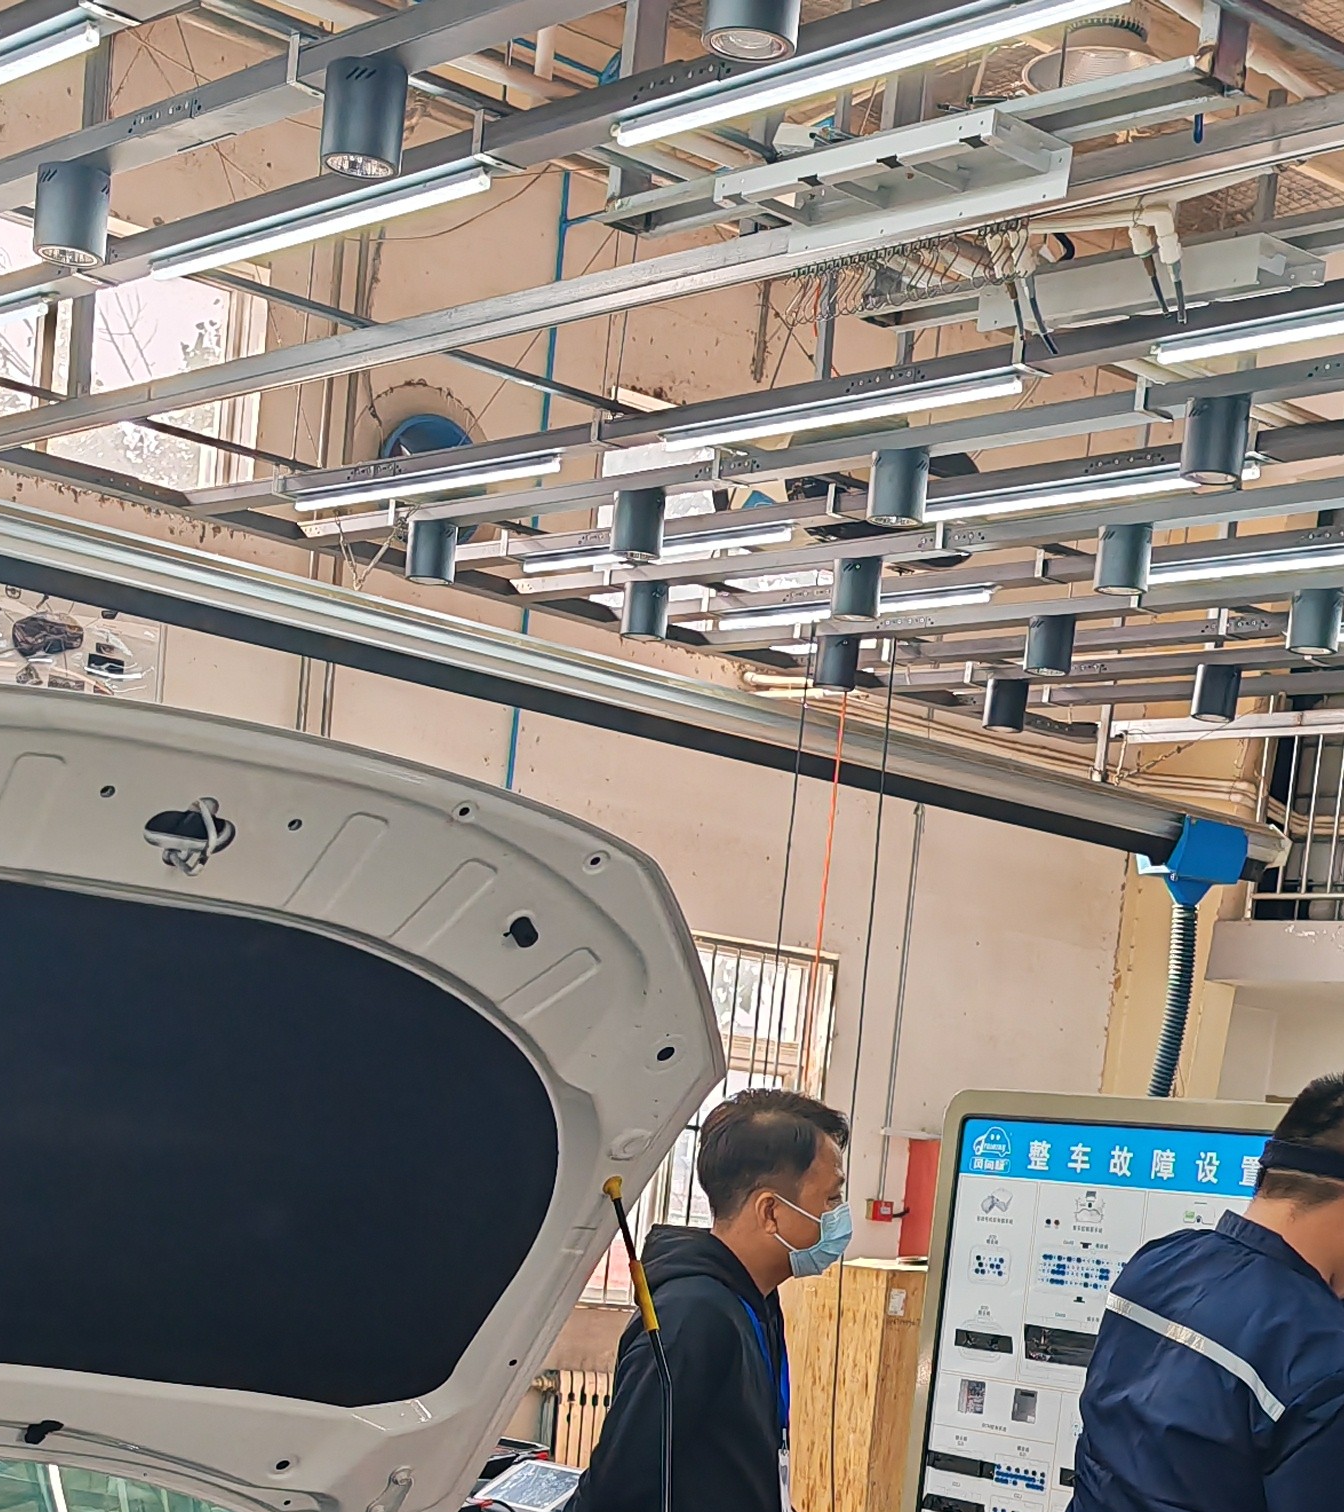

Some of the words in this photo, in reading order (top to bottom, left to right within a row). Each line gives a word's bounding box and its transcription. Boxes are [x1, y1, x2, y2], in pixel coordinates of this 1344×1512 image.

[1027, 1140, 1263, 1187] 整车故障设置
